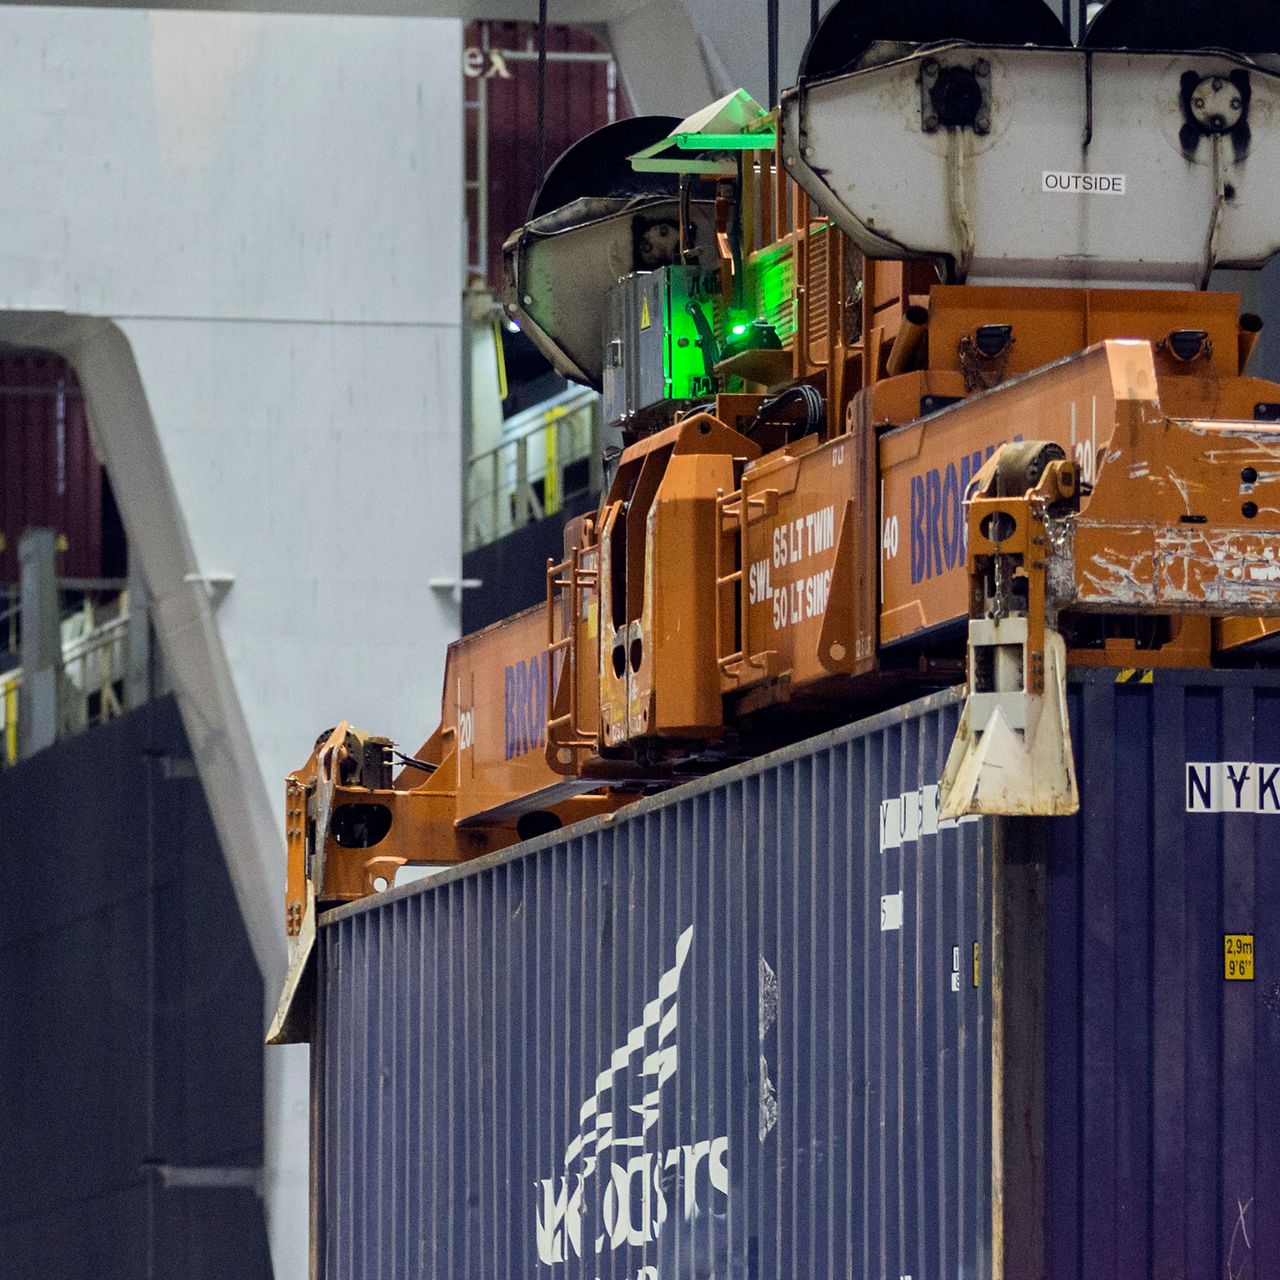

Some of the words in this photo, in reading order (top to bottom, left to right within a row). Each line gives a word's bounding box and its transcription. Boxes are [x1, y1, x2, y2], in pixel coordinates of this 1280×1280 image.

[1045, 174, 1122, 192] OUTSIDE
[773, 523, 787, 569] 65
[790, 517, 804, 563] LT
[806, 505, 835, 557] TWIN
[883, 515, 899, 560] 40
[749, 558, 772, 605] SWL
[773, 585, 787, 630] 50
[790, 579, 804, 625] LT
[806, 568, 833, 618] SING
